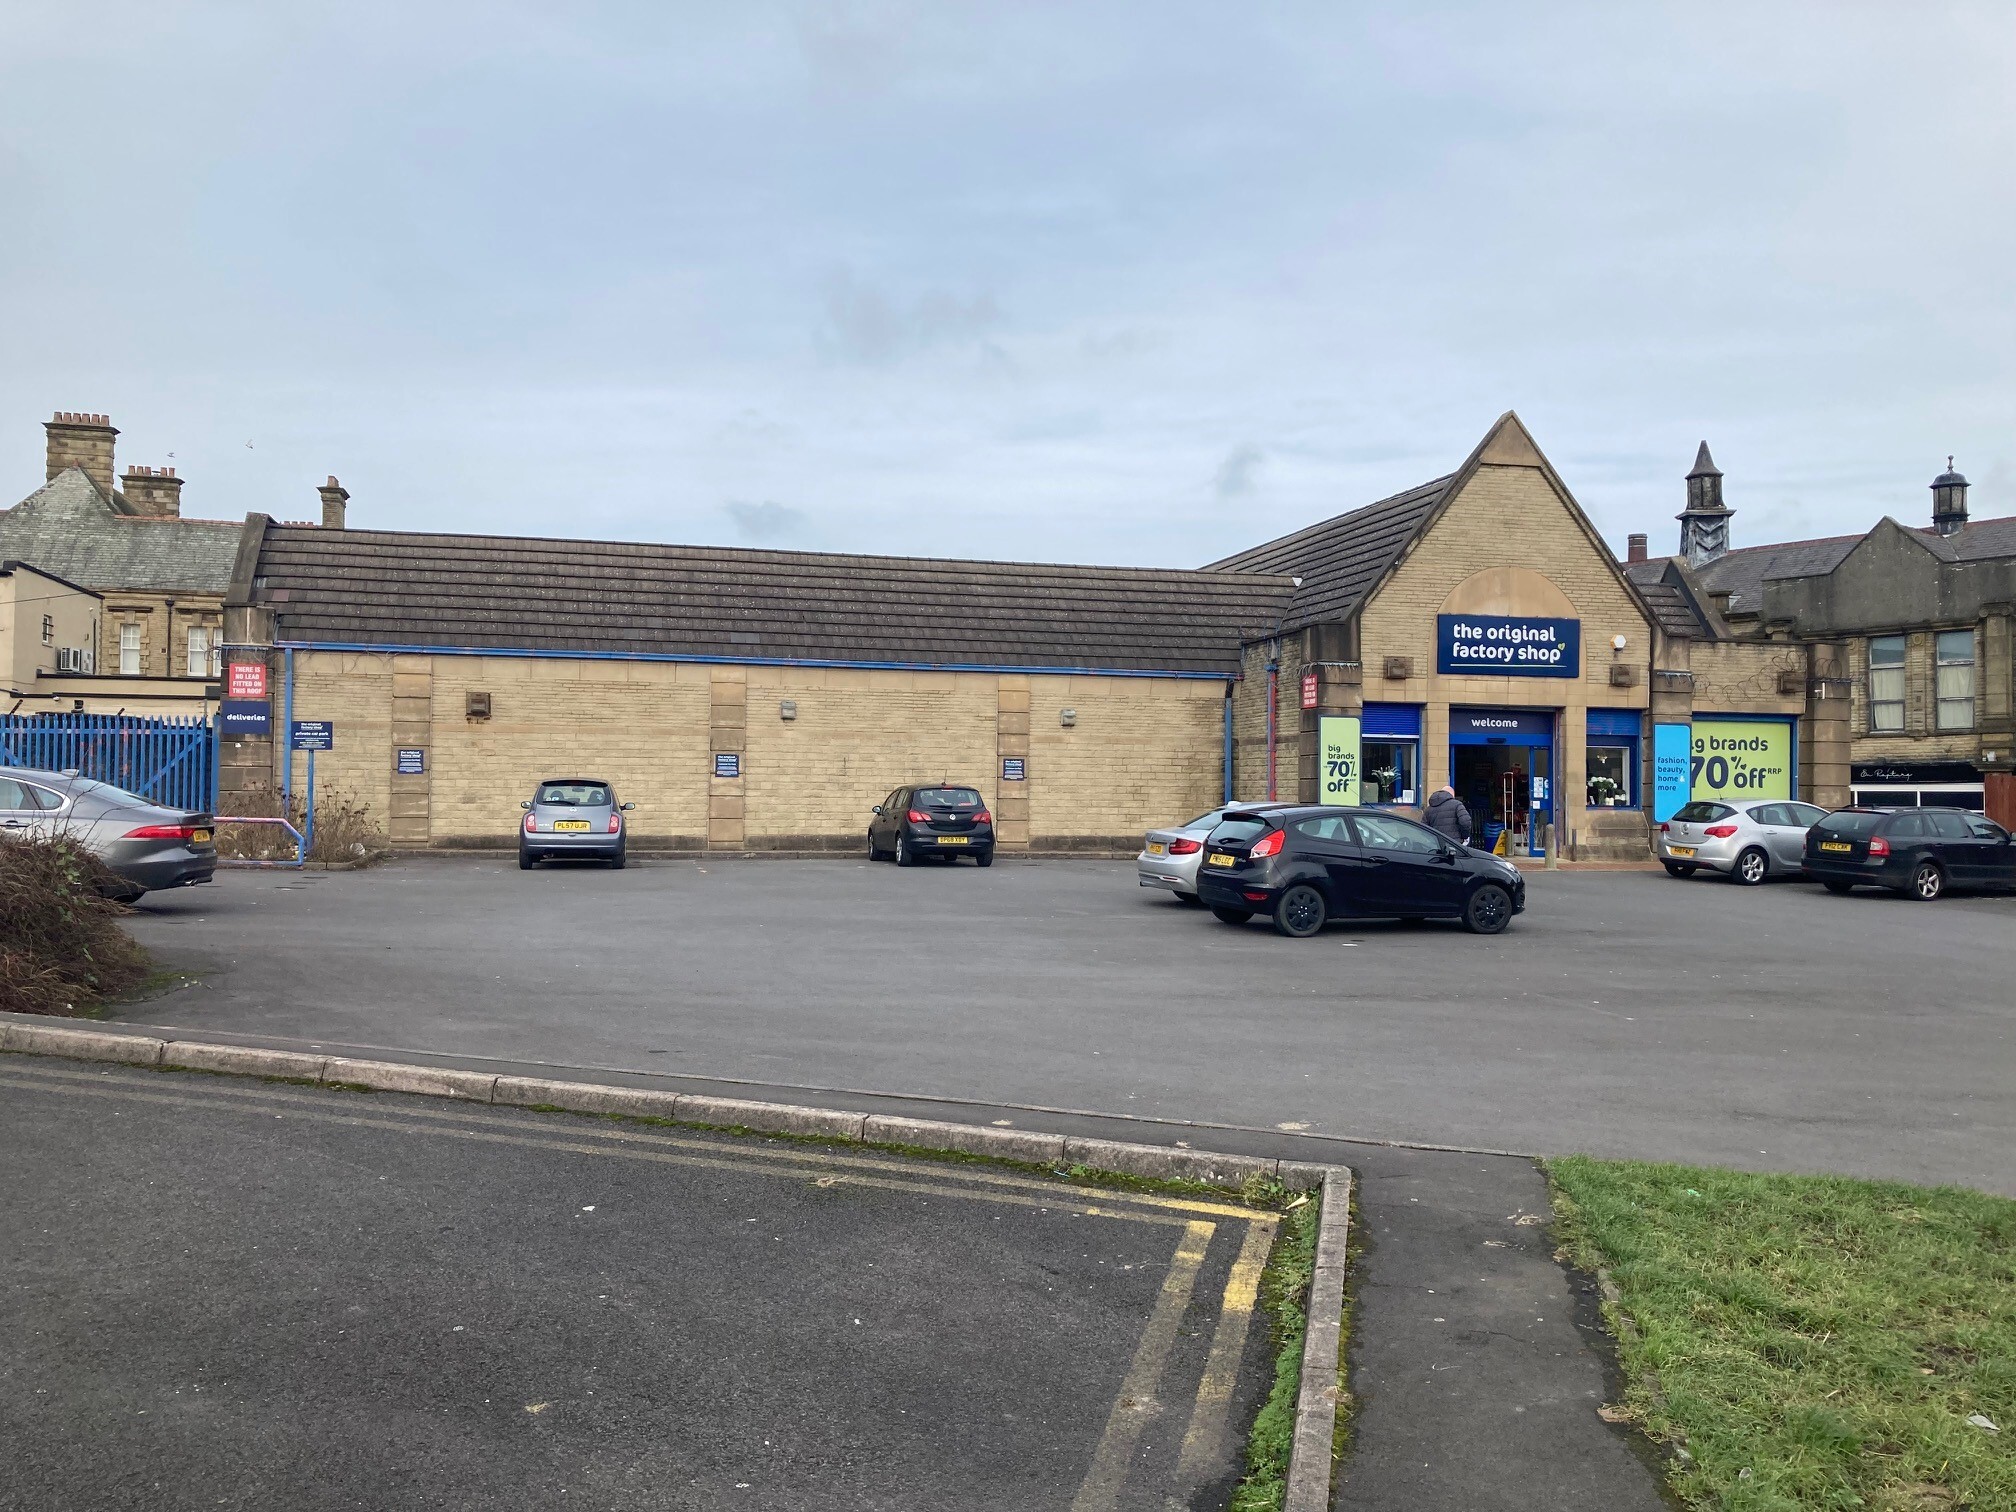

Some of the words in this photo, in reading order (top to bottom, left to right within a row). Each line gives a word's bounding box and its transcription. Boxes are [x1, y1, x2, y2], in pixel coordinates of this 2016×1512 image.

[1453, 623, 1483, 639] the
[1486, 624, 1556, 644] original
[1453, 641, 1514, 662] factory
[1517, 644, 1561, 663] shop
[226, 713, 266, 721] deliveries
[1471, 717, 1518, 727] welcome
[1328, 744, 1341, 753] big
[1710, 736, 1768, 751] brands
[1328, 752, 1355, 760] brands
[1658, 756, 1688, 765] fashion,
[1658, 766, 1686, 774] beauty,
[1733, 767, 1767, 788] off
[1327, 778, 1350, 793] off
